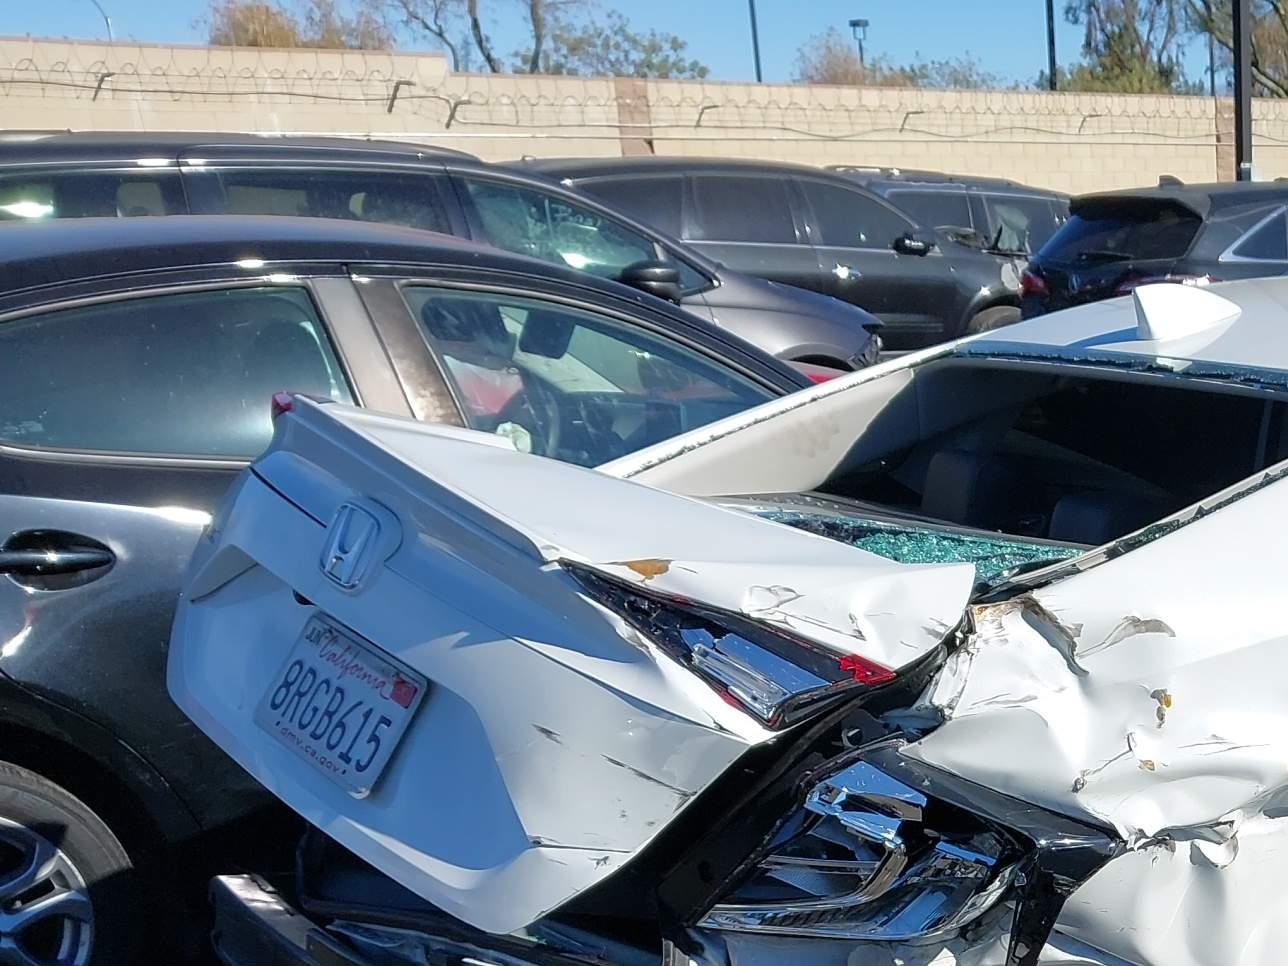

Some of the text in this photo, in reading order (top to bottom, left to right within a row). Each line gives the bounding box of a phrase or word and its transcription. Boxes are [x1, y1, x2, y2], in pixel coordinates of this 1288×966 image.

[319, 633, 389, 700] California
[270, 659, 392, 773] 8RGB615
[279, 727, 340, 773] dmv.ca.gov
